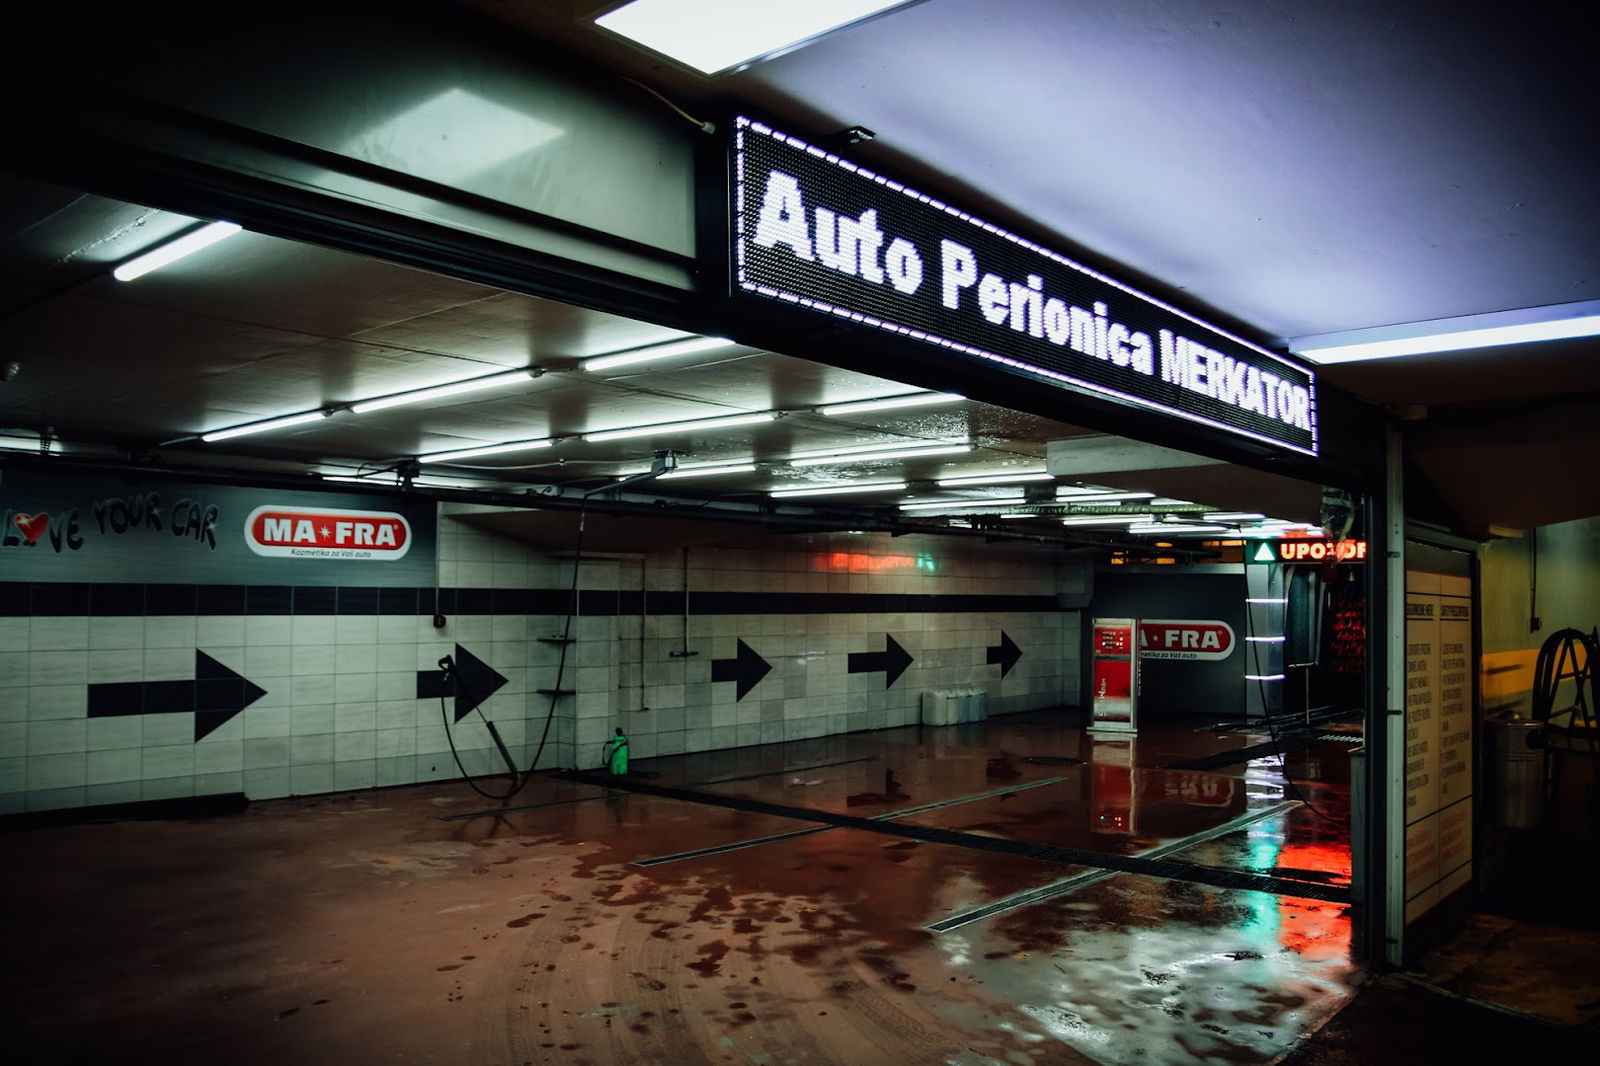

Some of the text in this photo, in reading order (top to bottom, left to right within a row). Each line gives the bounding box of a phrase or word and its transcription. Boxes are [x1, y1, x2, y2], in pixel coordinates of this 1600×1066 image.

[753, 169, 1312, 431] Auto Perionica MERKATOR
[93, 492, 162, 535] YOUR
[171, 499, 219, 550] CAR
[335, 522, 397, 546] FRA
[1165, 629, 1220, 649] FRA
